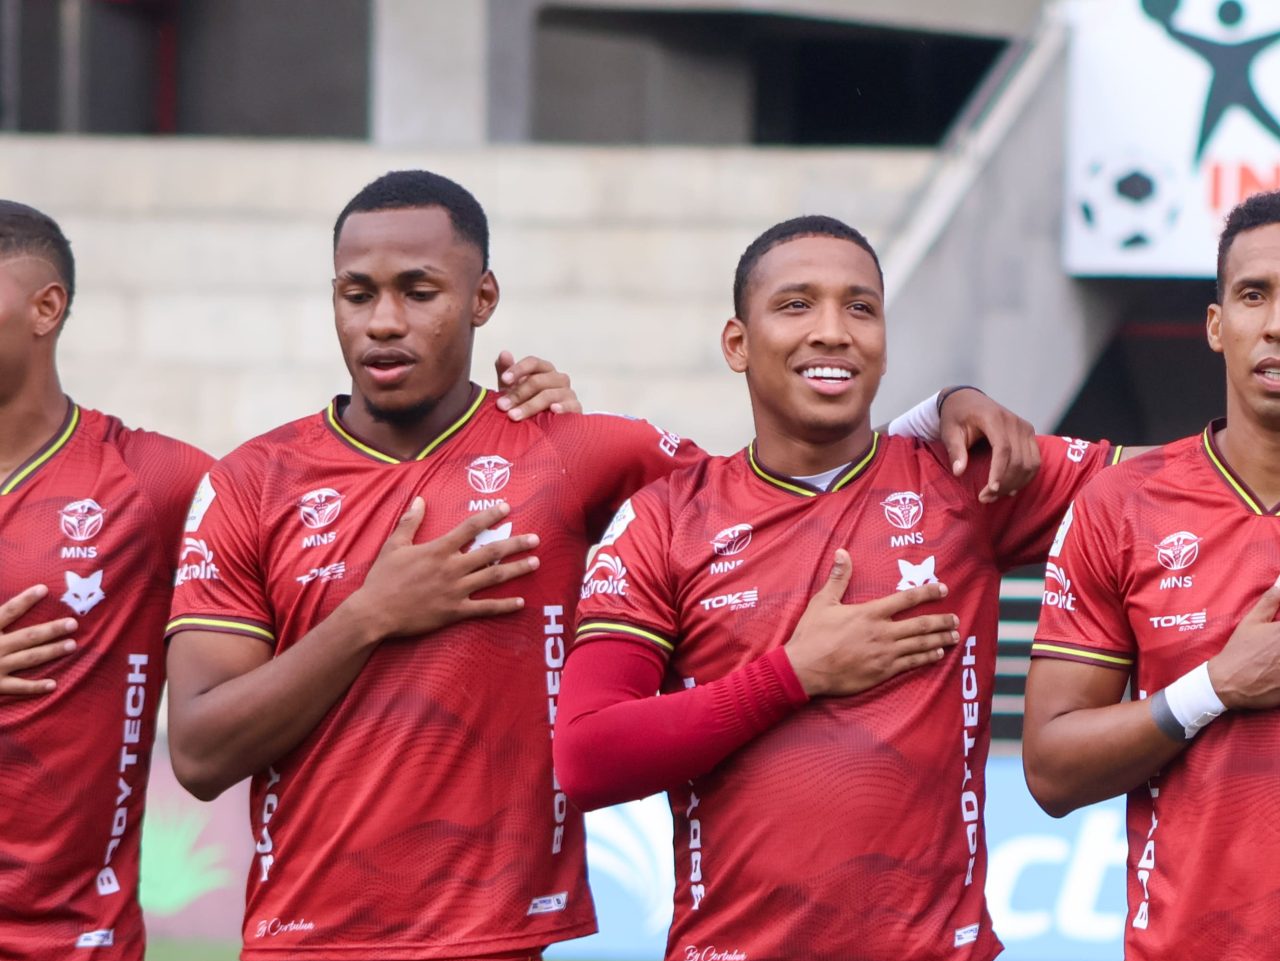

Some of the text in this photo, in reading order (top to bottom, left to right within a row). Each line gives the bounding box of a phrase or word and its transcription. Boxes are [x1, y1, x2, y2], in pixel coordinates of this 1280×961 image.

[303, 531, 338, 549] MNS
[890, 531, 925, 548] MNS
[60, 546, 98, 559] MNS
[1159, 575, 1194, 590] MNS
[701, 590, 759, 611] TOKE
[1149, 611, 1207, 628] TOKE
